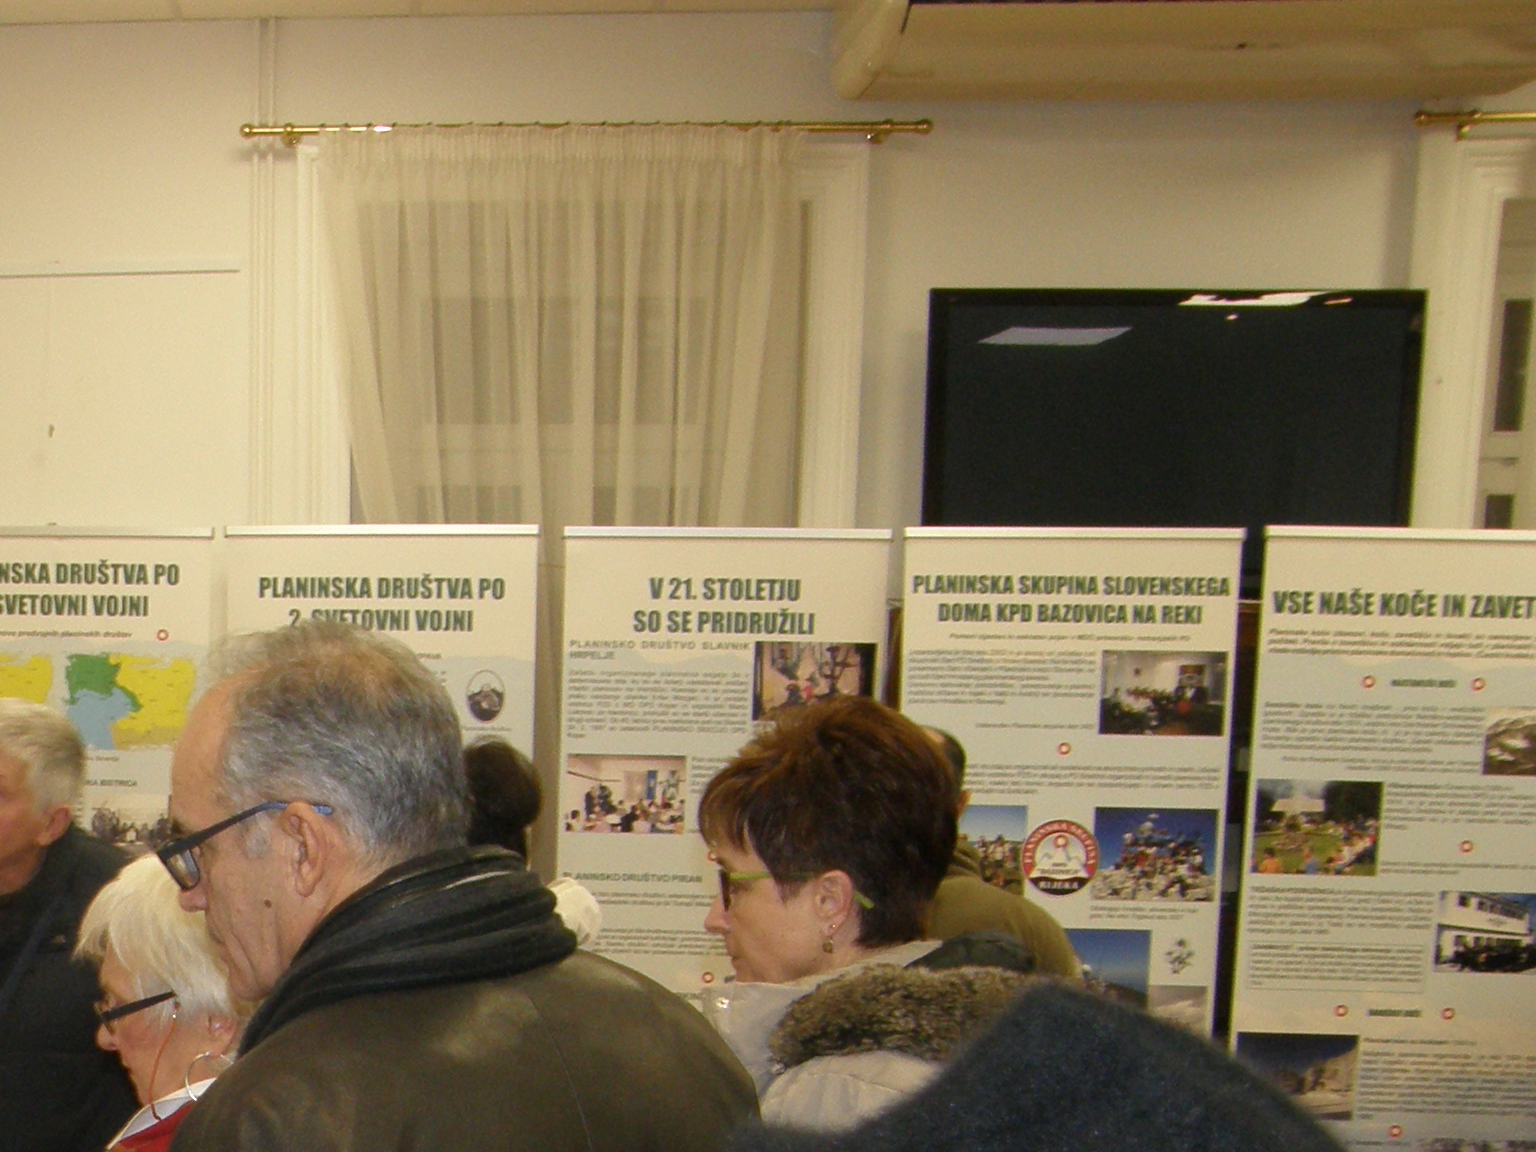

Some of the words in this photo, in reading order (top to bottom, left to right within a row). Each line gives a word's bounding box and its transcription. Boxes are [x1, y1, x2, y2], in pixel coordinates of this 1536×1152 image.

[56, 559, 150, 586] DRUŠTVA
[154, 563, 181, 586] PO
[259, 576, 371, 599] PLANINSKA
[377, 573, 473, 600] DRUŠTVA
[479, 577, 506, 600] PO
[649, 577, 664, 600] V
[669, 578, 697, 600] 21.
[703, 578, 802, 601] STOLETJU
[913, 575, 1013, 594] PLANINSKA
[1019, 575, 1098, 595] SKUPINA
[1104, 575, 1230, 596] SLOVENSKEGA
[93, 594, 150, 617] VOJNI
[938, 602, 991, 622] DOMA
[996, 603, 1032, 622] KPD
[1037, 604, 1127, 623] BAZOVICA
[1132, 604, 1156, 623] NA
[1161, 605, 1203, 624] REKI
[1273, 590, 1313, 614] VSE
[1319, 588, 1375, 615] NAŠE
[1380, 589, 1437, 616] KOČE
[1443, 594, 1465, 616] IN
[415, 609, 474, 632] VOJNI
[633, 610, 662, 633] SO
[667, 610, 692, 633] SE
[697, 608, 815, 635] PRIDRUŽILI
[569, 639, 635, 650] PLANINSKO
[641, 637, 697, 650] DRUŠTVO
[702, 640, 750, 650] SLAVNIK
[569, 650, 615, 660] HRPELJE
[622, 872, 670, 883] DRUŠTVO
